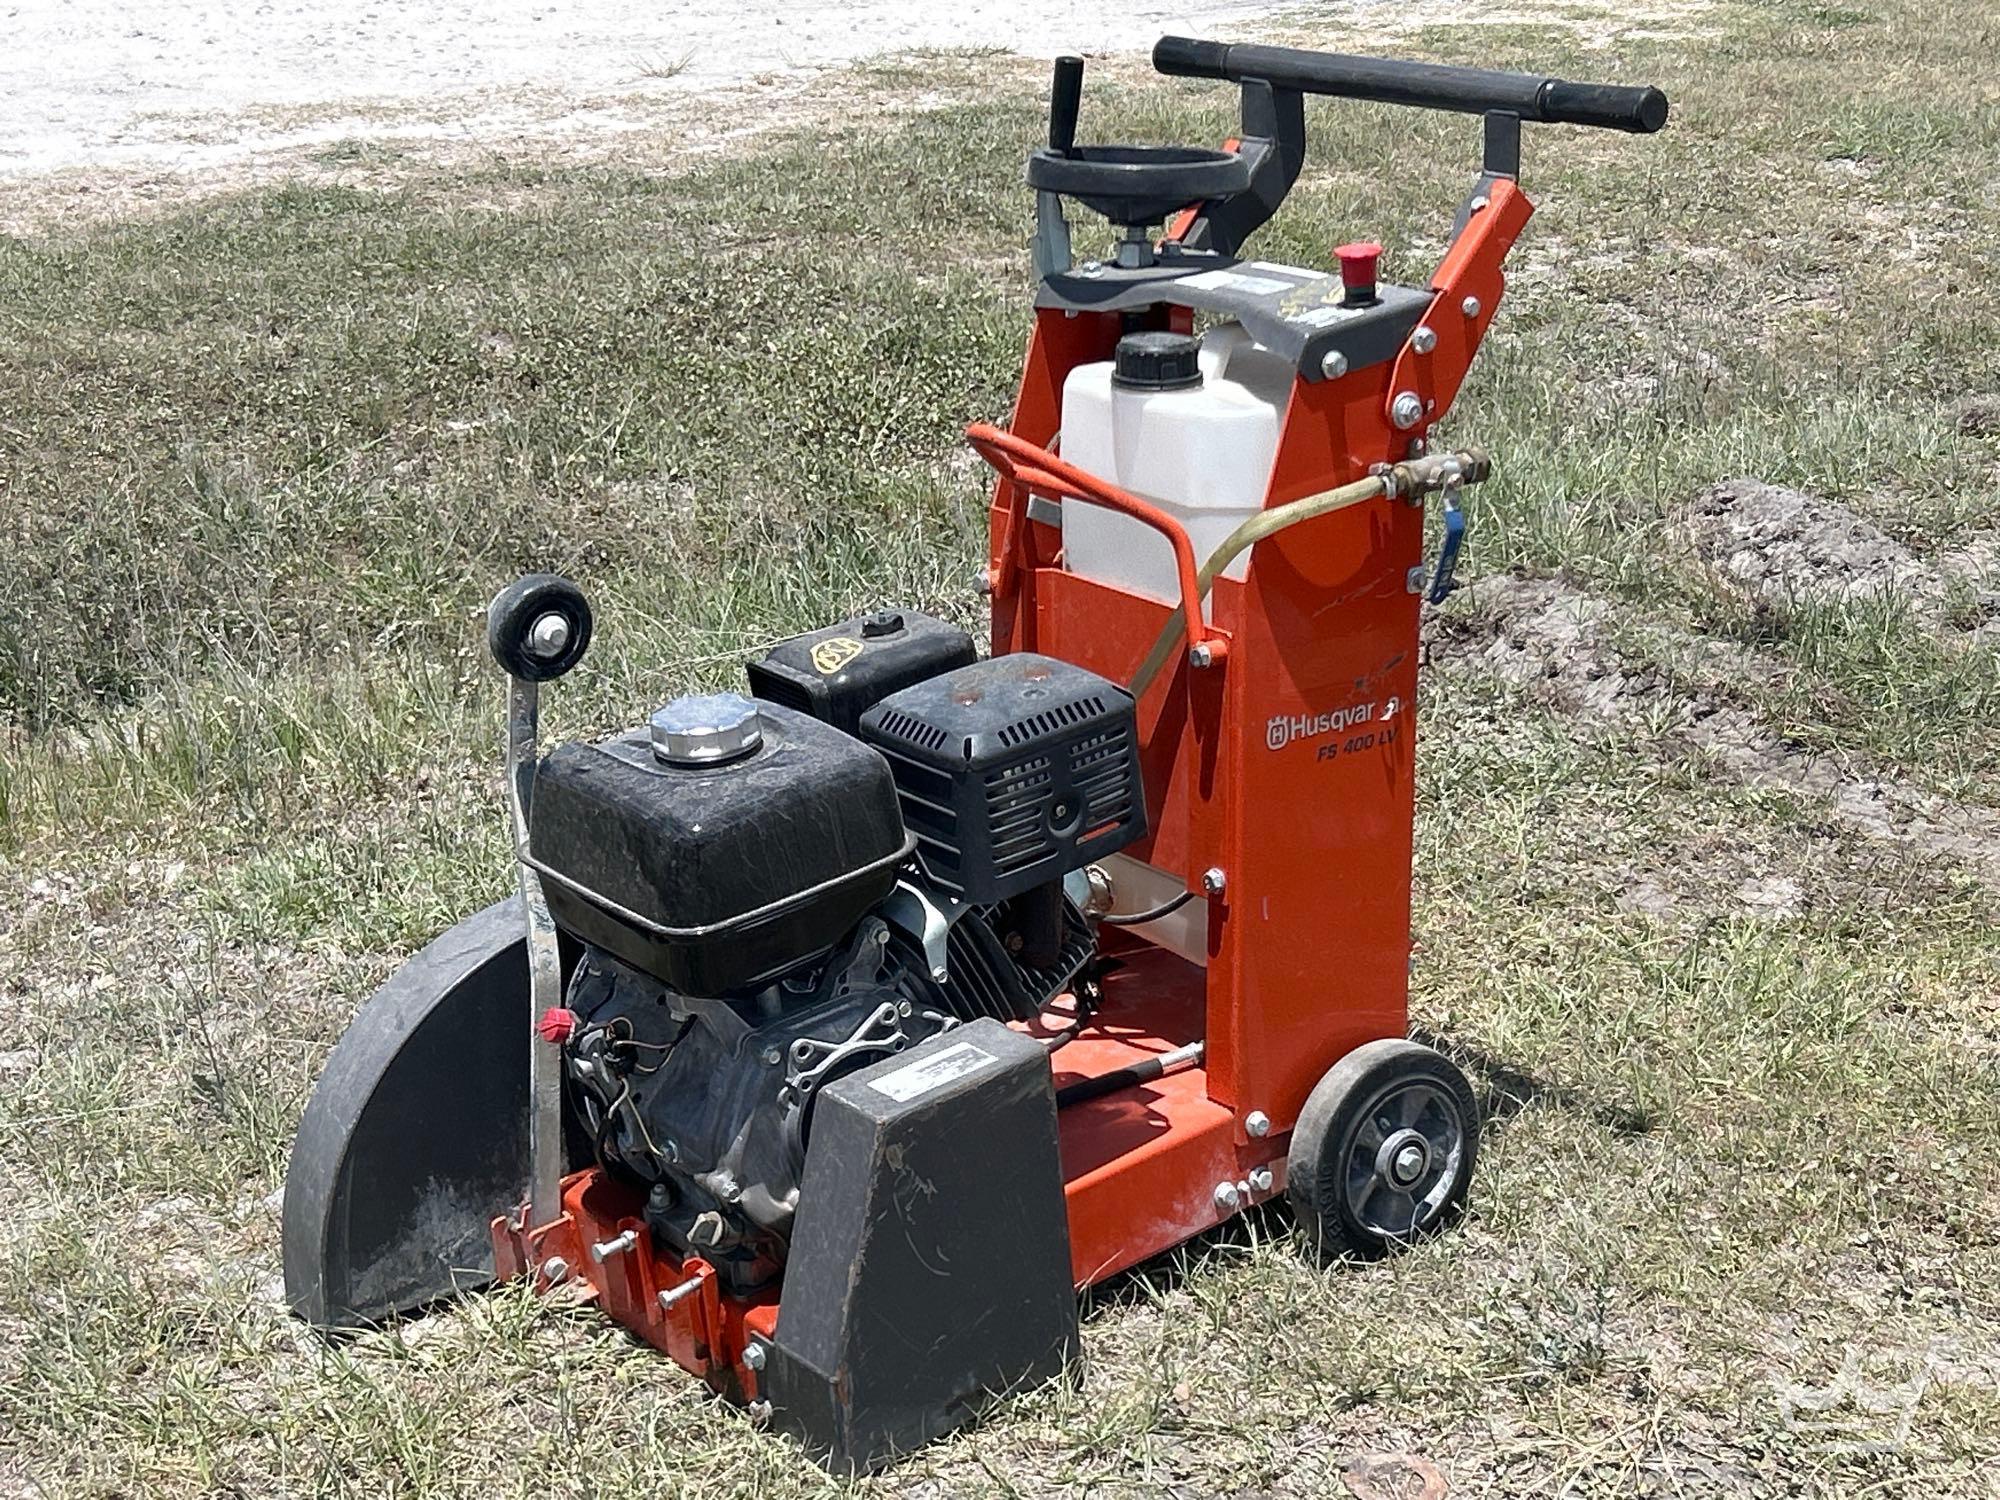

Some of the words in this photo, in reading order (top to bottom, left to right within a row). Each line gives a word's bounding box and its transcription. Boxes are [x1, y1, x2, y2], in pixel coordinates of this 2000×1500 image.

[1290, 697, 1400, 740] Husqvara
[1317, 743, 1338, 762] FS
[1343, 734, 1375, 755] 400
[1378, 728, 1398, 746] LV
